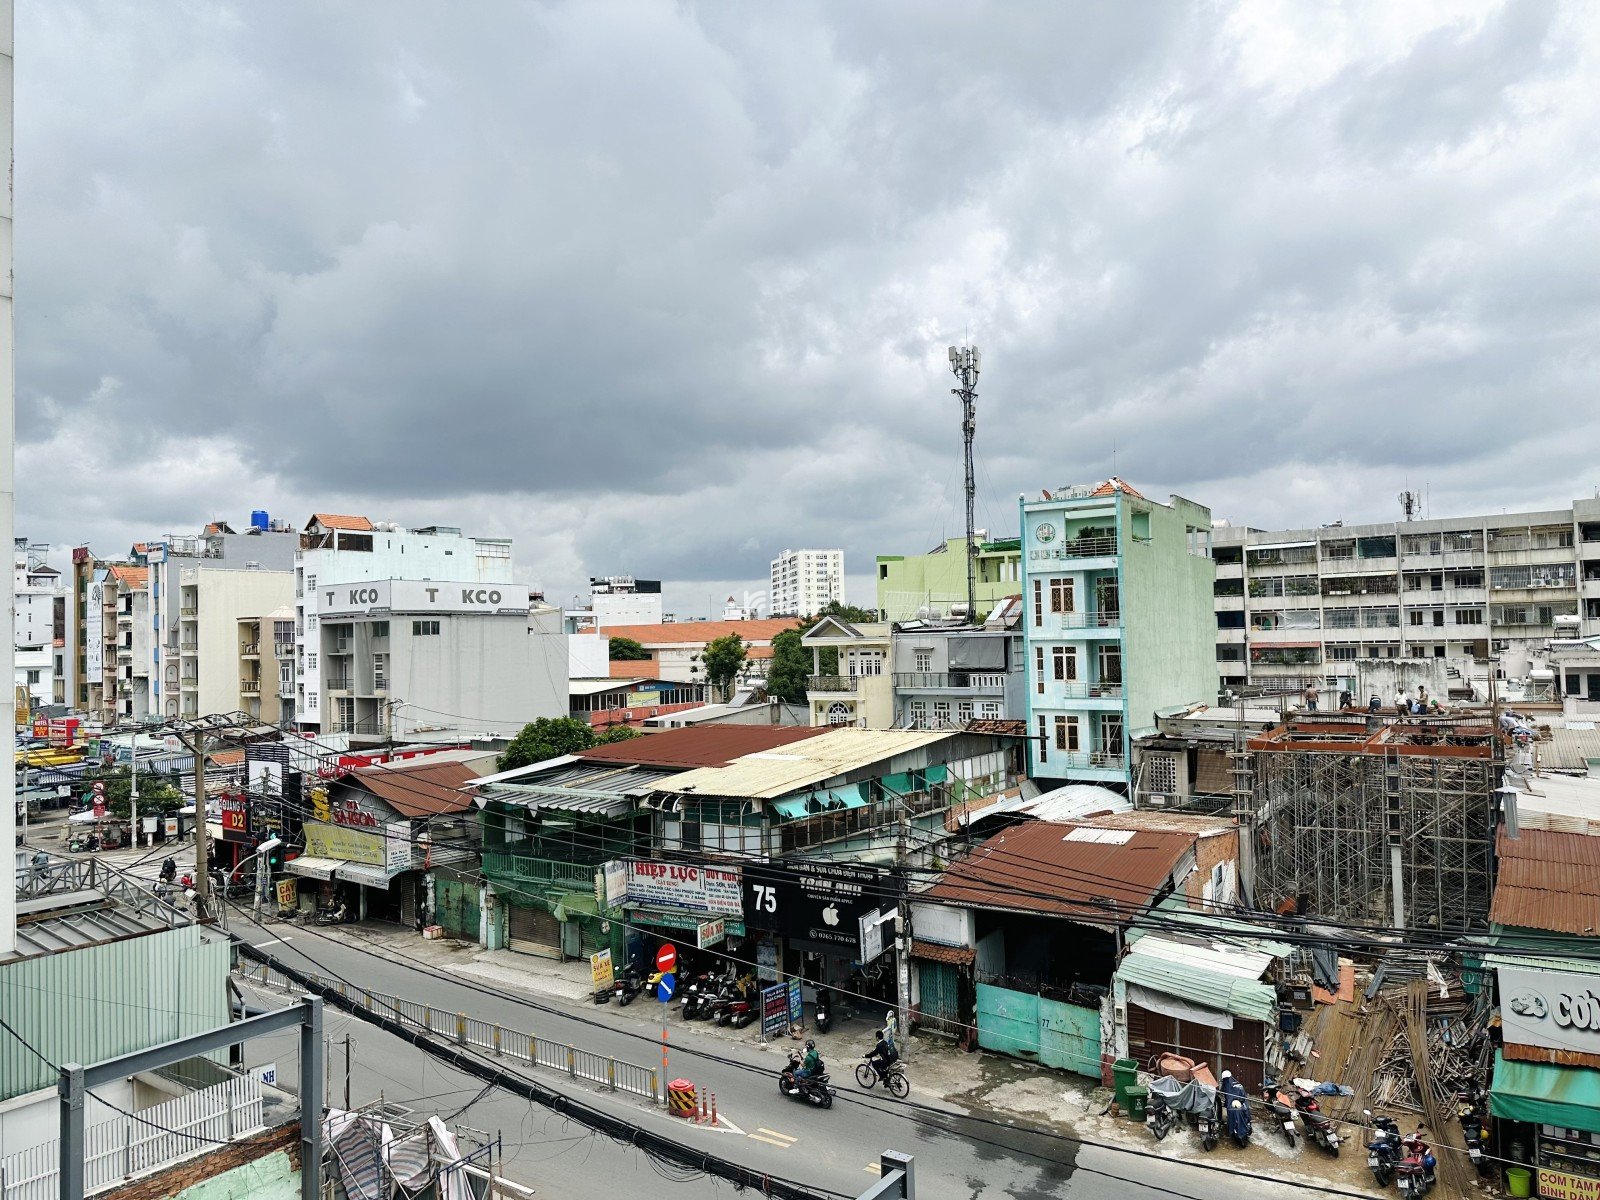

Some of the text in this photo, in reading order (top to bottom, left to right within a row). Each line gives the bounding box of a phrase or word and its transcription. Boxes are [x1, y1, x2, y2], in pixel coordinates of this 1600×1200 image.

[350, 588, 378, 604] KCO
[462, 589, 502, 604] KCO
[232, 813, 244, 828] D2
[752, 884, 777, 913] 75
[1042, 1018, 1050, 1028] 77
[1539, 1172, 1567, 1187] CƠM
[1540, 1184, 1566, 1199] BÌNH
